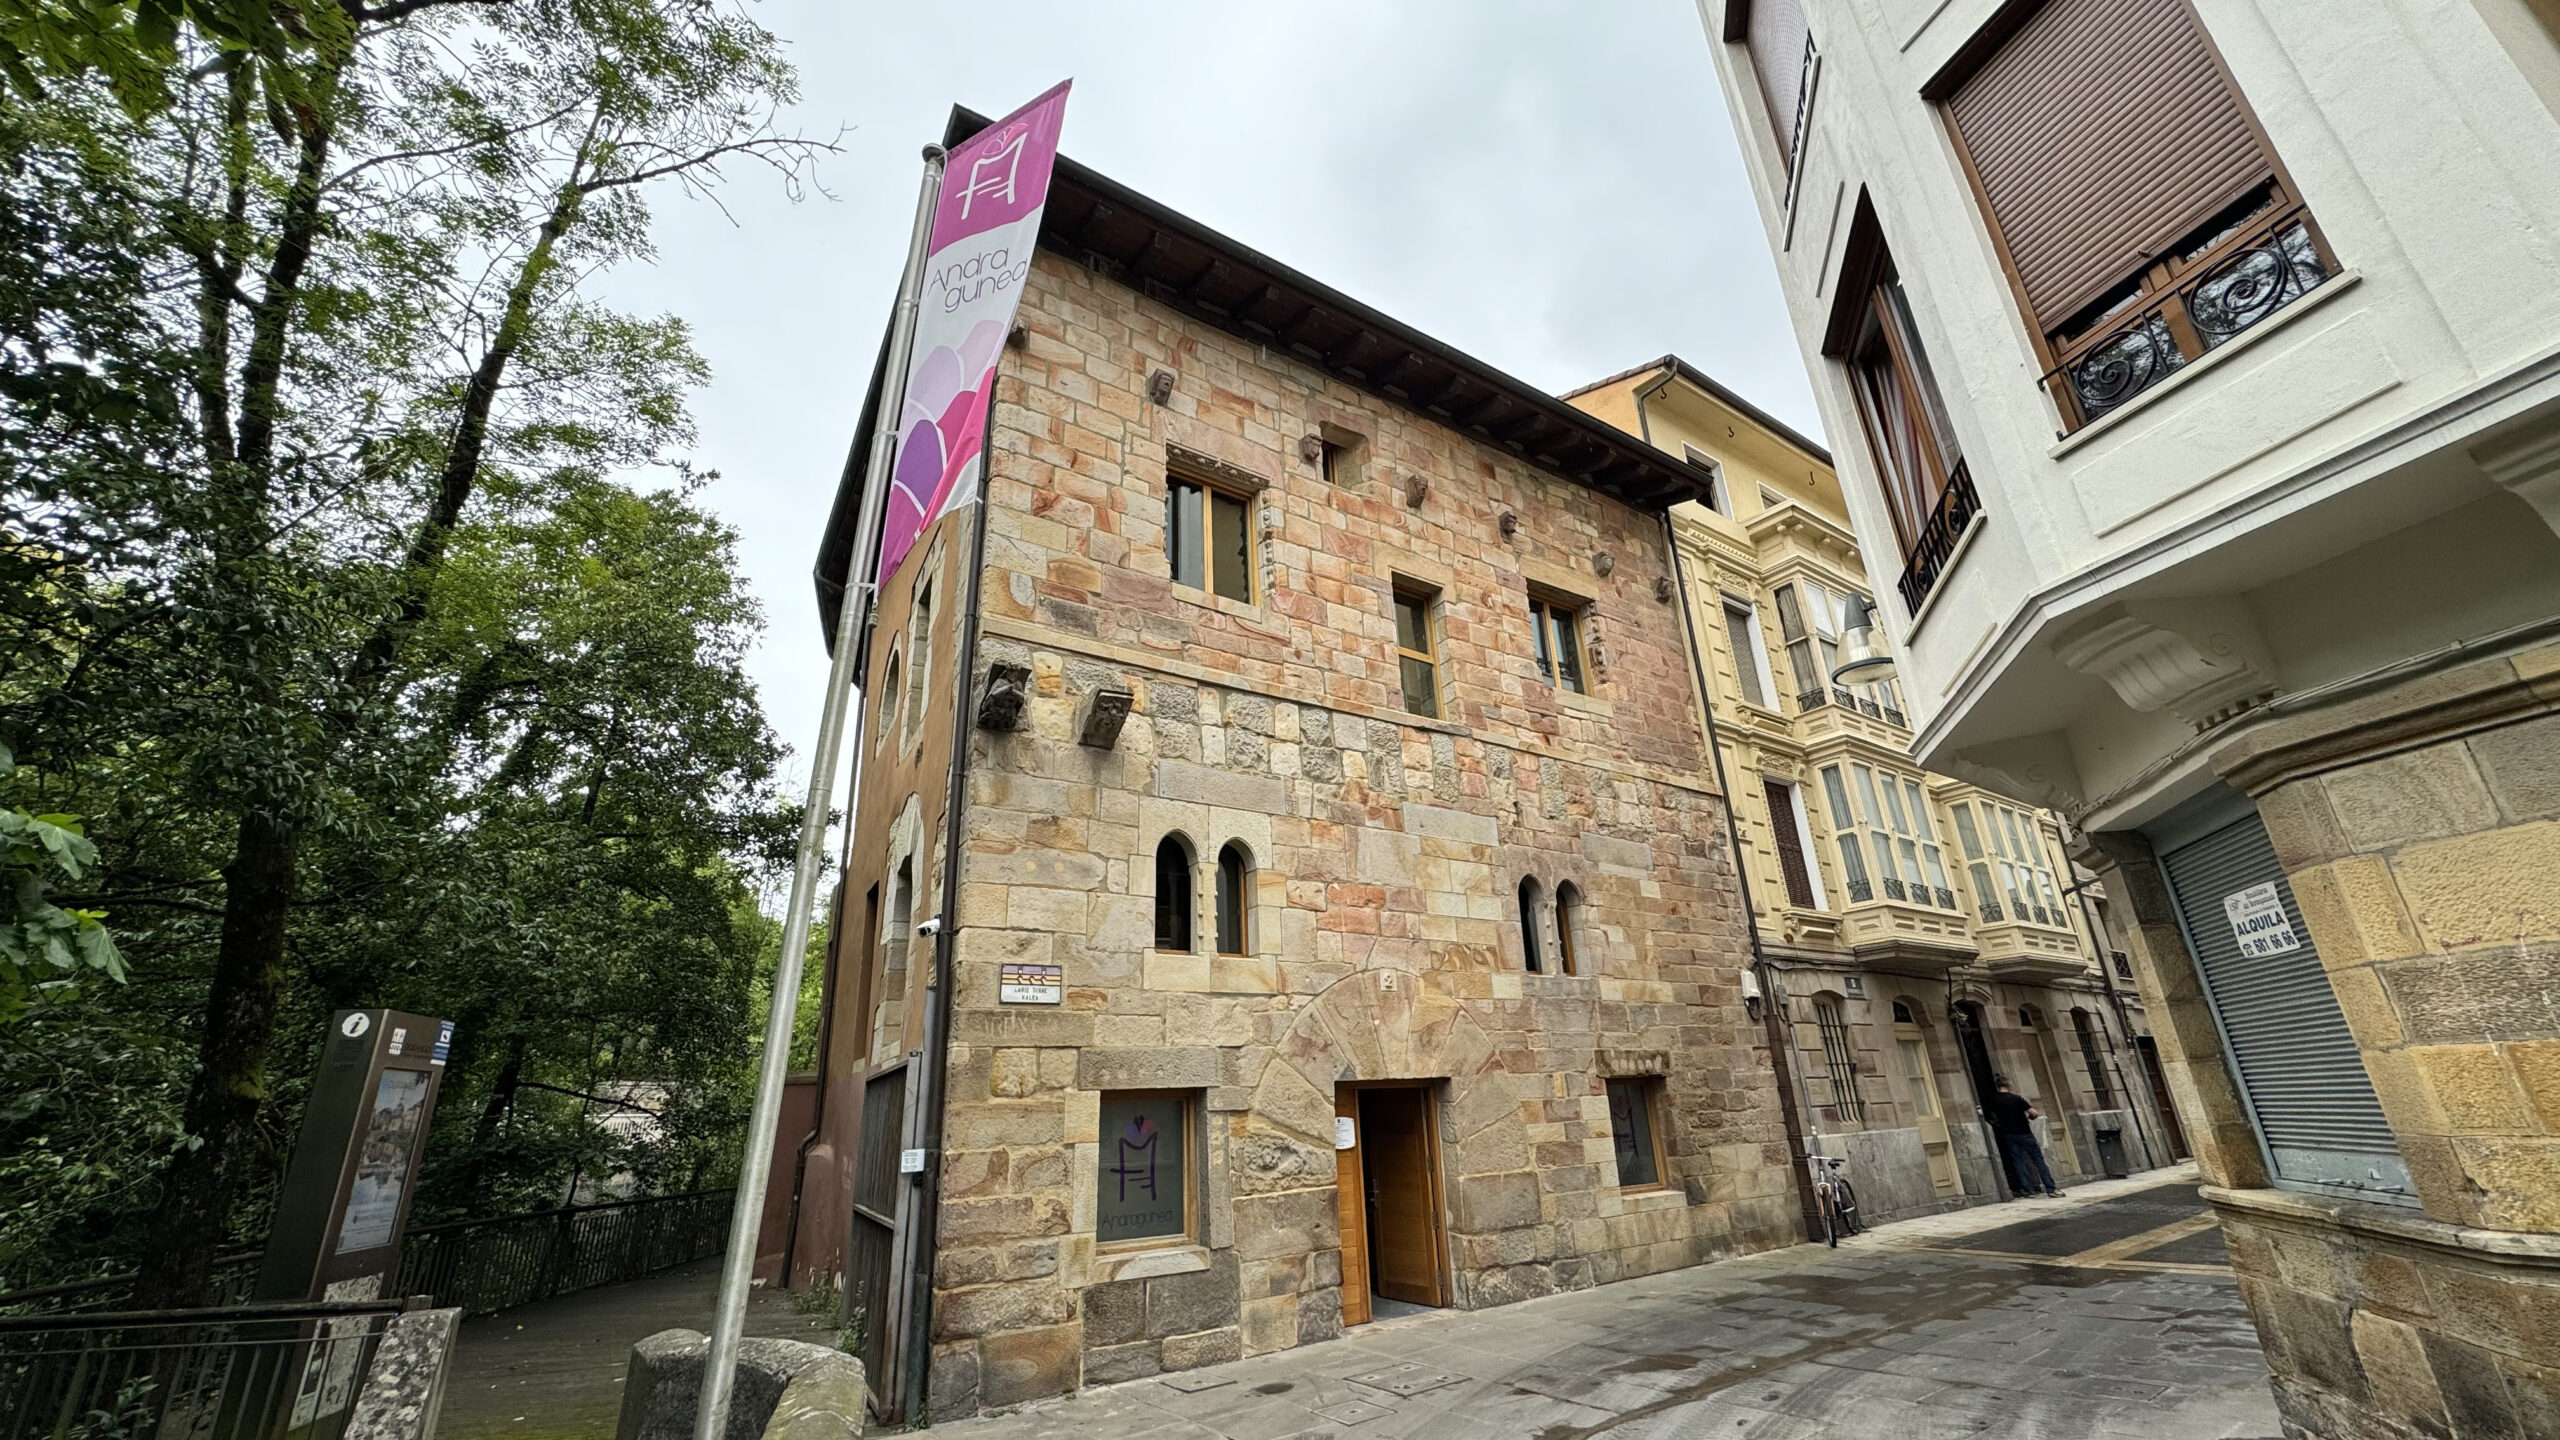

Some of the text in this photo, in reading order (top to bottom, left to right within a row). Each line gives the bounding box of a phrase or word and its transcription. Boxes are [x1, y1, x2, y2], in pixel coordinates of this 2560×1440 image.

[928, 248, 1009, 295] Andra
[944, 258, 1028, 313] gunea
[2236, 911, 2285, 936] ALQUILA
[2253, 930, 2296, 953] 681 66 66
